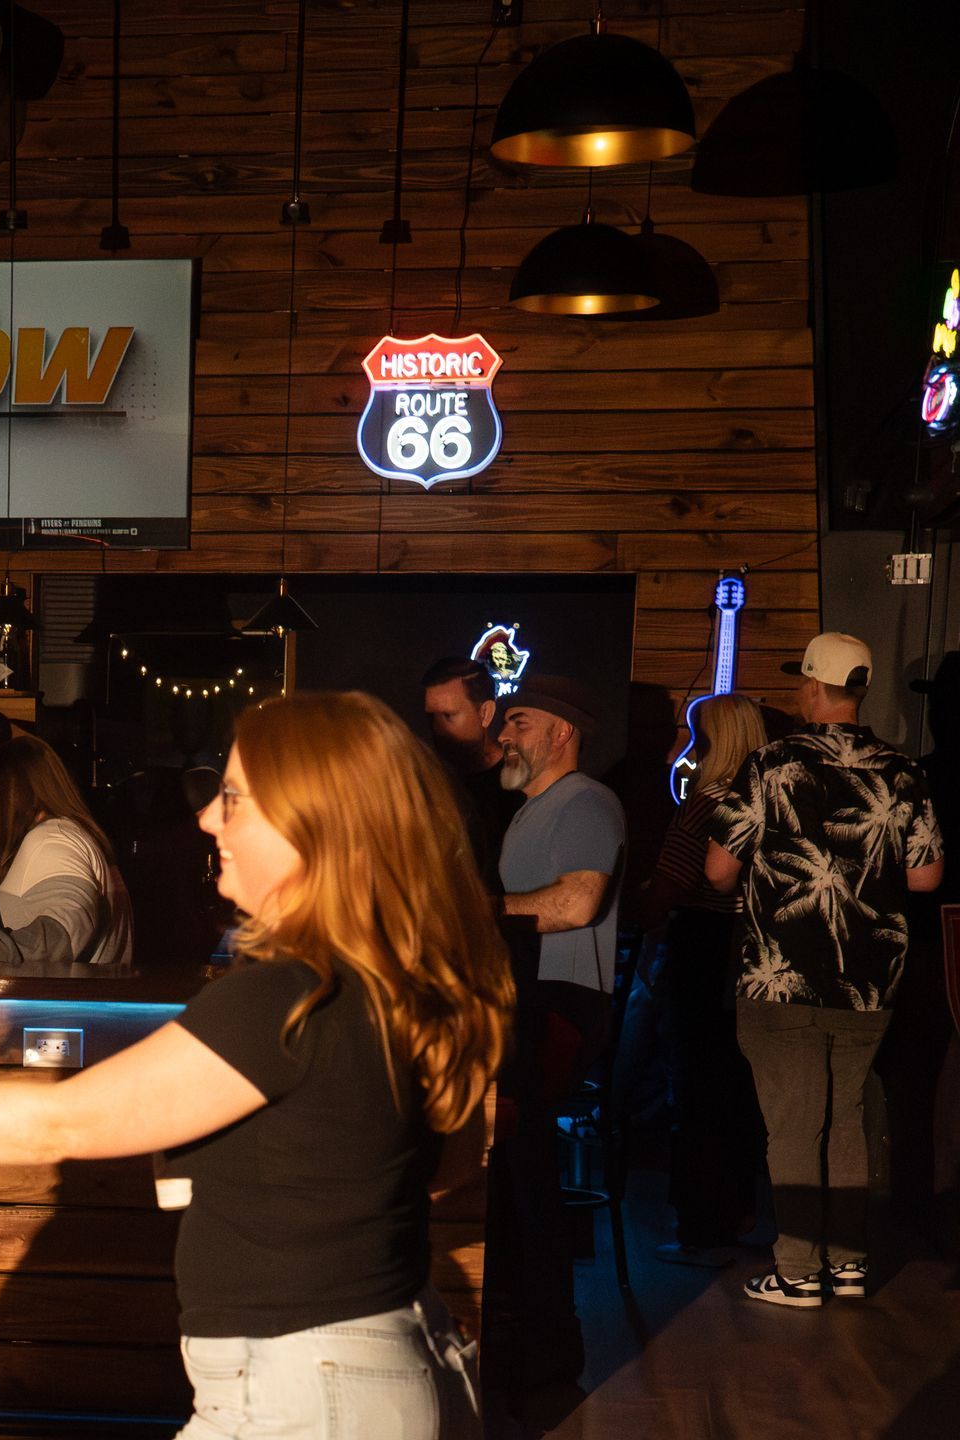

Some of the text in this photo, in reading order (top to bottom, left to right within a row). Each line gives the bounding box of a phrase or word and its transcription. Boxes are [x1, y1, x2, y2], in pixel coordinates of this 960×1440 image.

[380, 351, 483, 378] HISTORIC
[395, 392, 469, 417] ROUTE
[386, 415, 472, 470] 66
